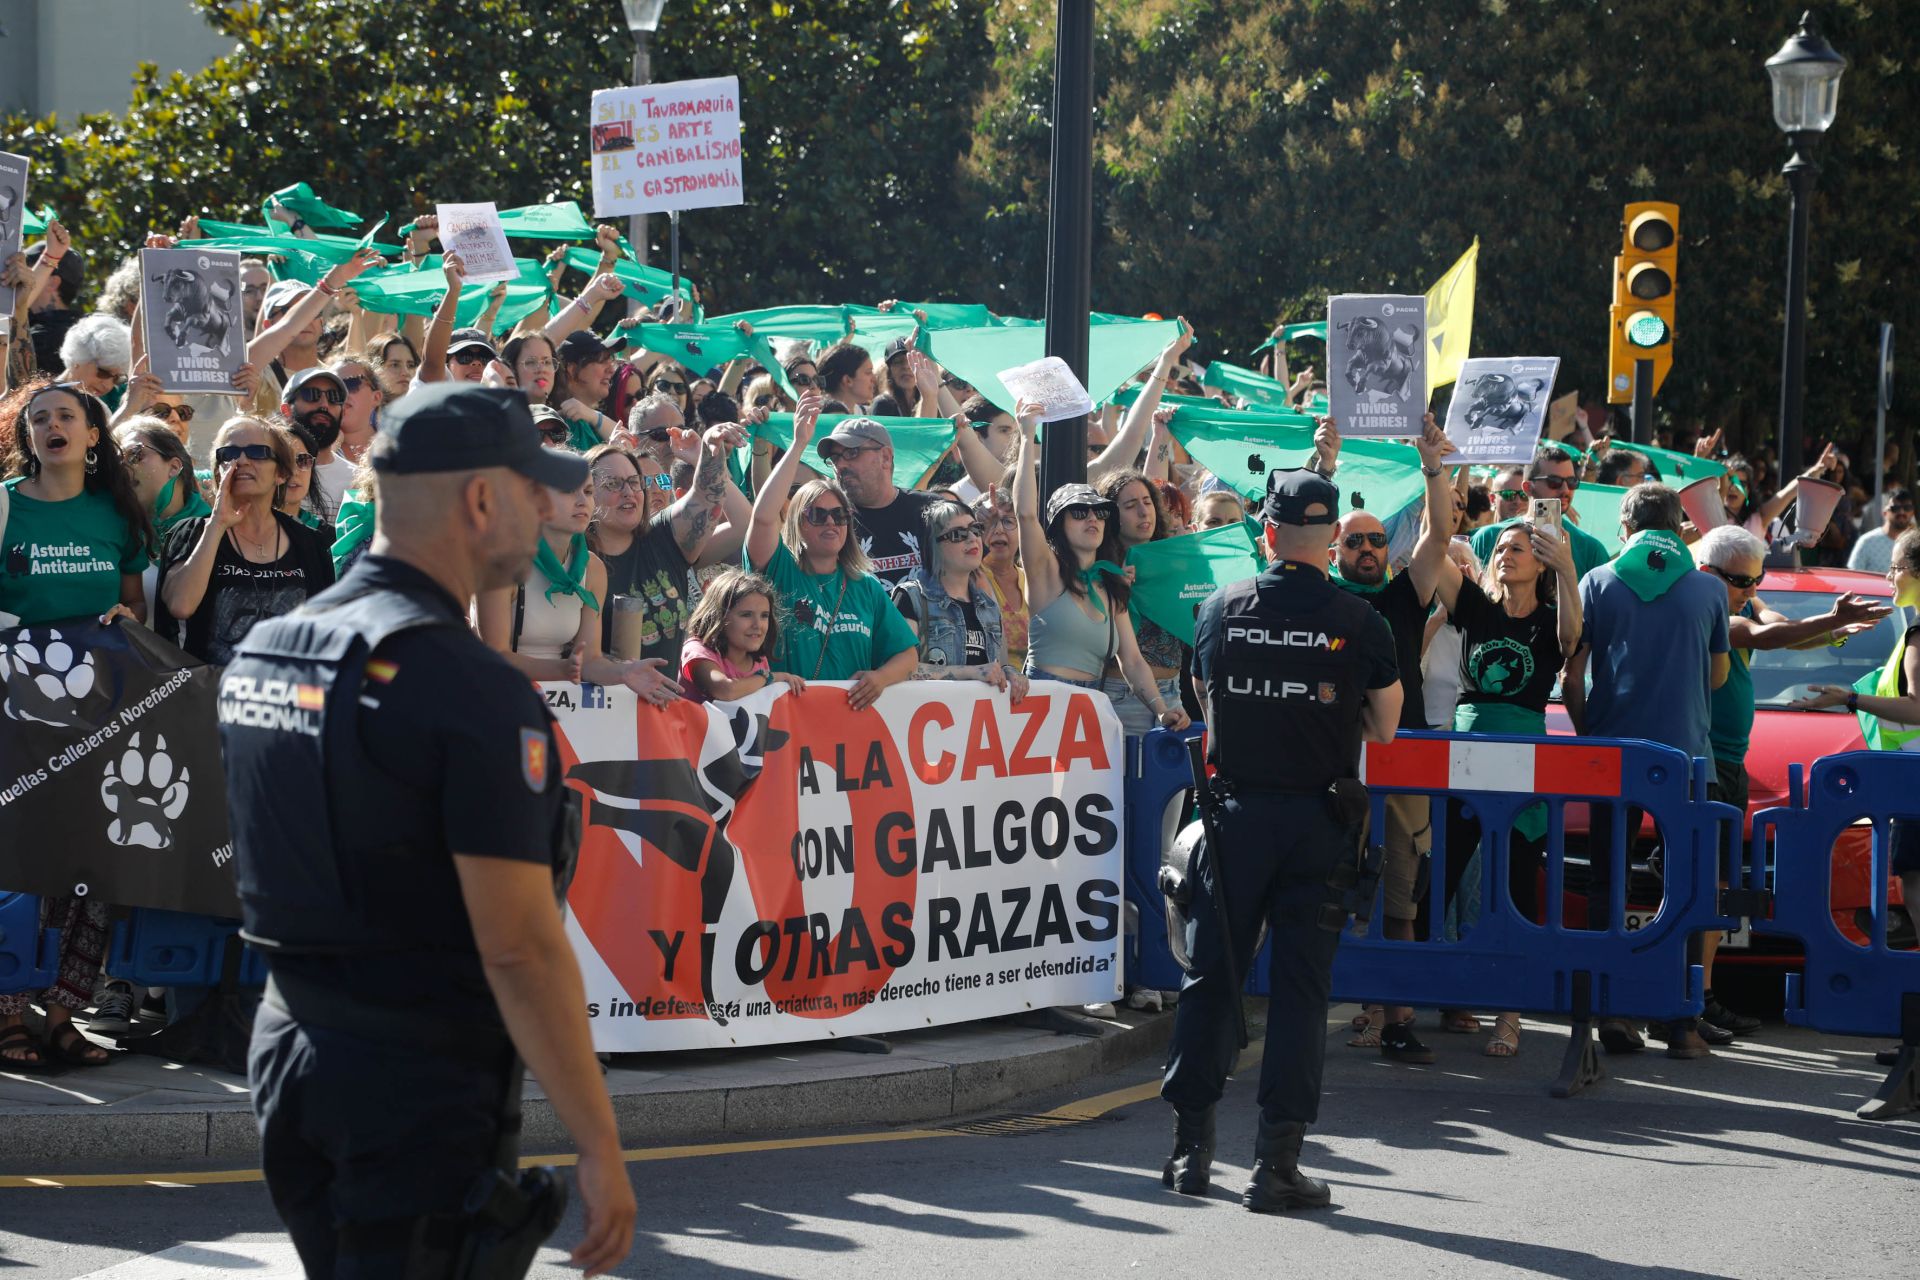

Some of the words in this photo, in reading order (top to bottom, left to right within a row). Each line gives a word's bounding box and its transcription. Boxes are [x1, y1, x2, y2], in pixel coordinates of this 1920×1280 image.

[636, 124, 660, 143] ES
[669, 120, 713, 139] ARTE
[602, 155, 621, 171] EL
[613, 179, 636, 199] ES
[170, 370, 179, 382] Y
[181, 370, 229, 383] LIBRES!
[1348, 416, 1358, 428] Y
[1359, 416, 1408, 428] LIBRES!
[1470, 445, 1516, 455] LIBRES!
[30, 542, 91, 558] Asturies
[31, 557, 115, 575] Antitaurina
[1184, 583, 1216, 591] Asturies
[1227, 627, 1331, 648] POLICIA
[221, 675, 299, 707] POLICIA
[1227, 676, 1316, 701] U.I.P.
[48, 721, 121, 773] Callejeras
[119, 667, 193, 727] Noreñenses
[219, 700, 320, 736] NACIONAL
[799, 746, 820, 796] A
[835, 740, 893, 792] LA
[908, 692, 1111, 785] CAZA
[791, 824, 854, 882] CON
[875, 793, 1118, 877] GALGOS
[647, 930, 685, 982] Y
[734, 903, 916, 986] OTRAS
[927, 878, 1120, 962] RAZAS
[609, 995, 706, 1018] indefensa
[710, 999, 740, 1019] está
[746, 1000, 771, 1017] una
[775, 994, 838, 1015] criatura,
[842, 985, 875, 1008] más
[880, 976, 940, 1002] derecho
[945, 970, 981, 993] tiene
[986, 971, 994, 987] a
[998, 967, 1021, 984] ser
